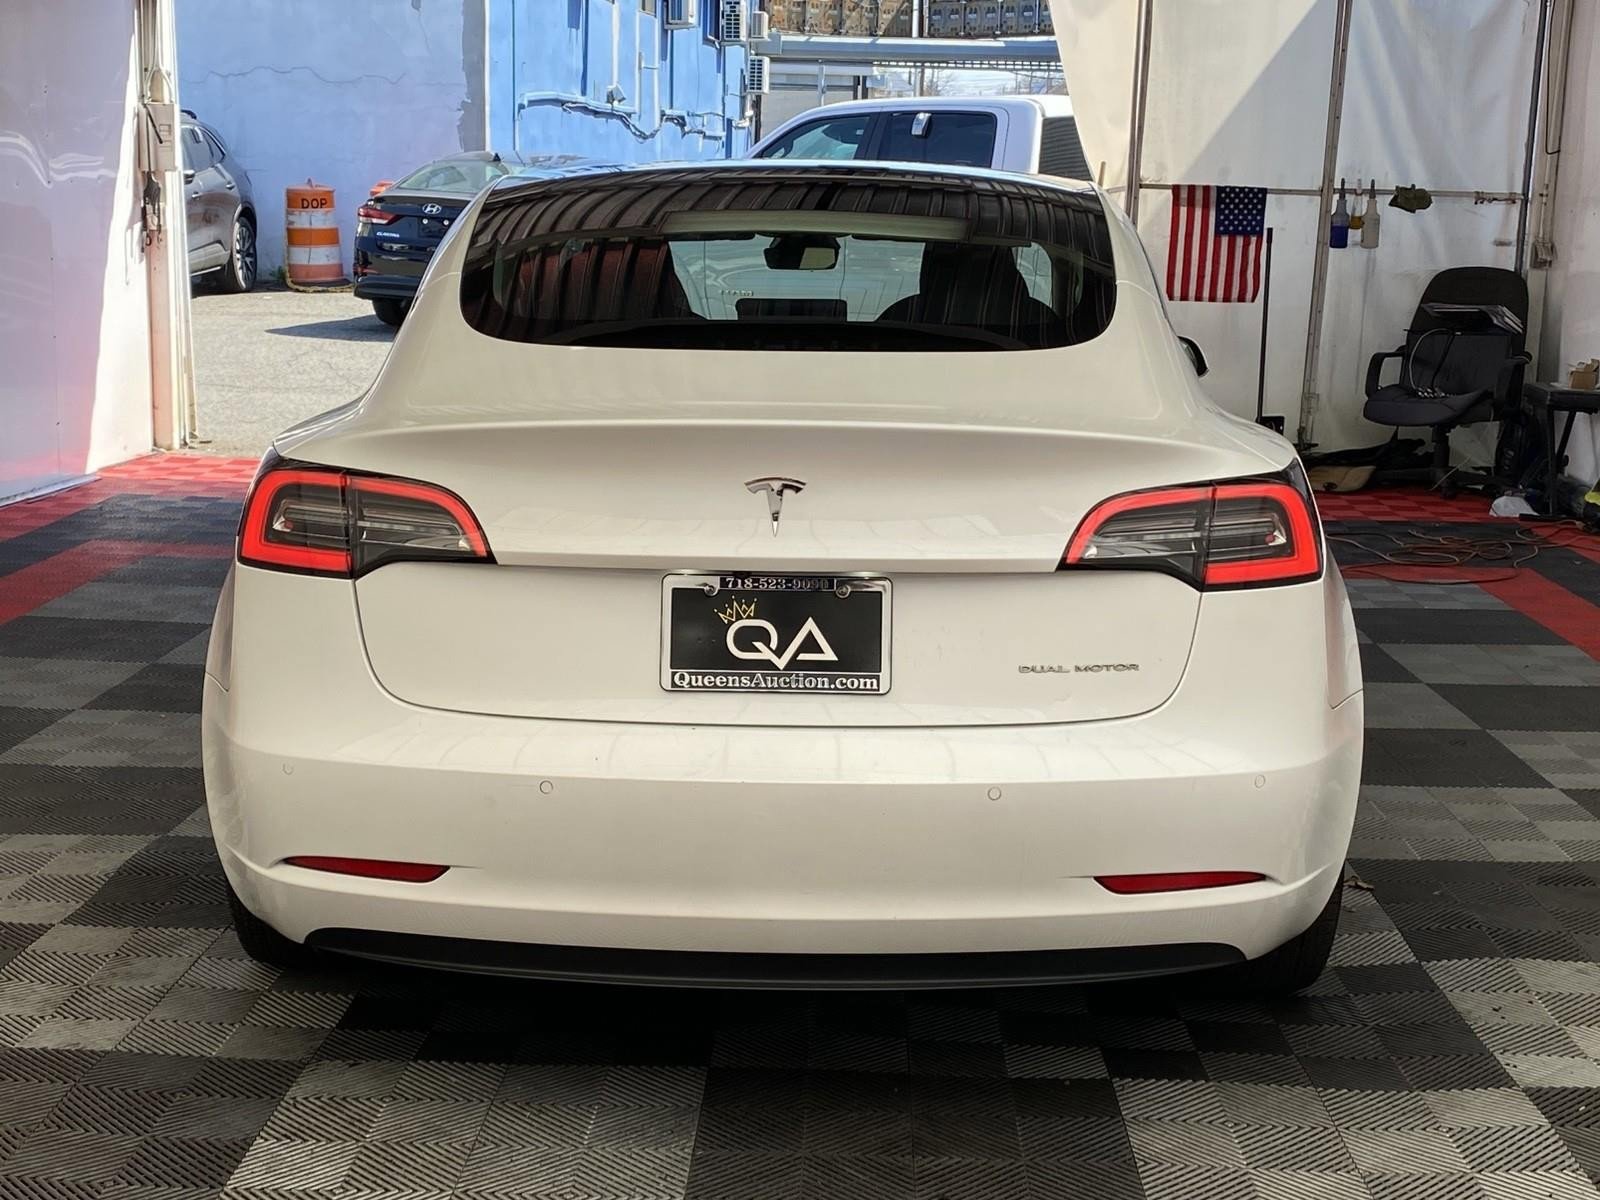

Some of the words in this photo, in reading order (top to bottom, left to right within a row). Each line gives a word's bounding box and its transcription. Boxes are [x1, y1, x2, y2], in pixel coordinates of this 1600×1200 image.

[301, 198, 328, 209] DOP
[726, 617, 839, 670] QA
[1018, 665, 1071, 673] DUAL
[1074, 664, 1139, 673] MOTOR
[673, 671, 879, 691] QueensAuction.com
